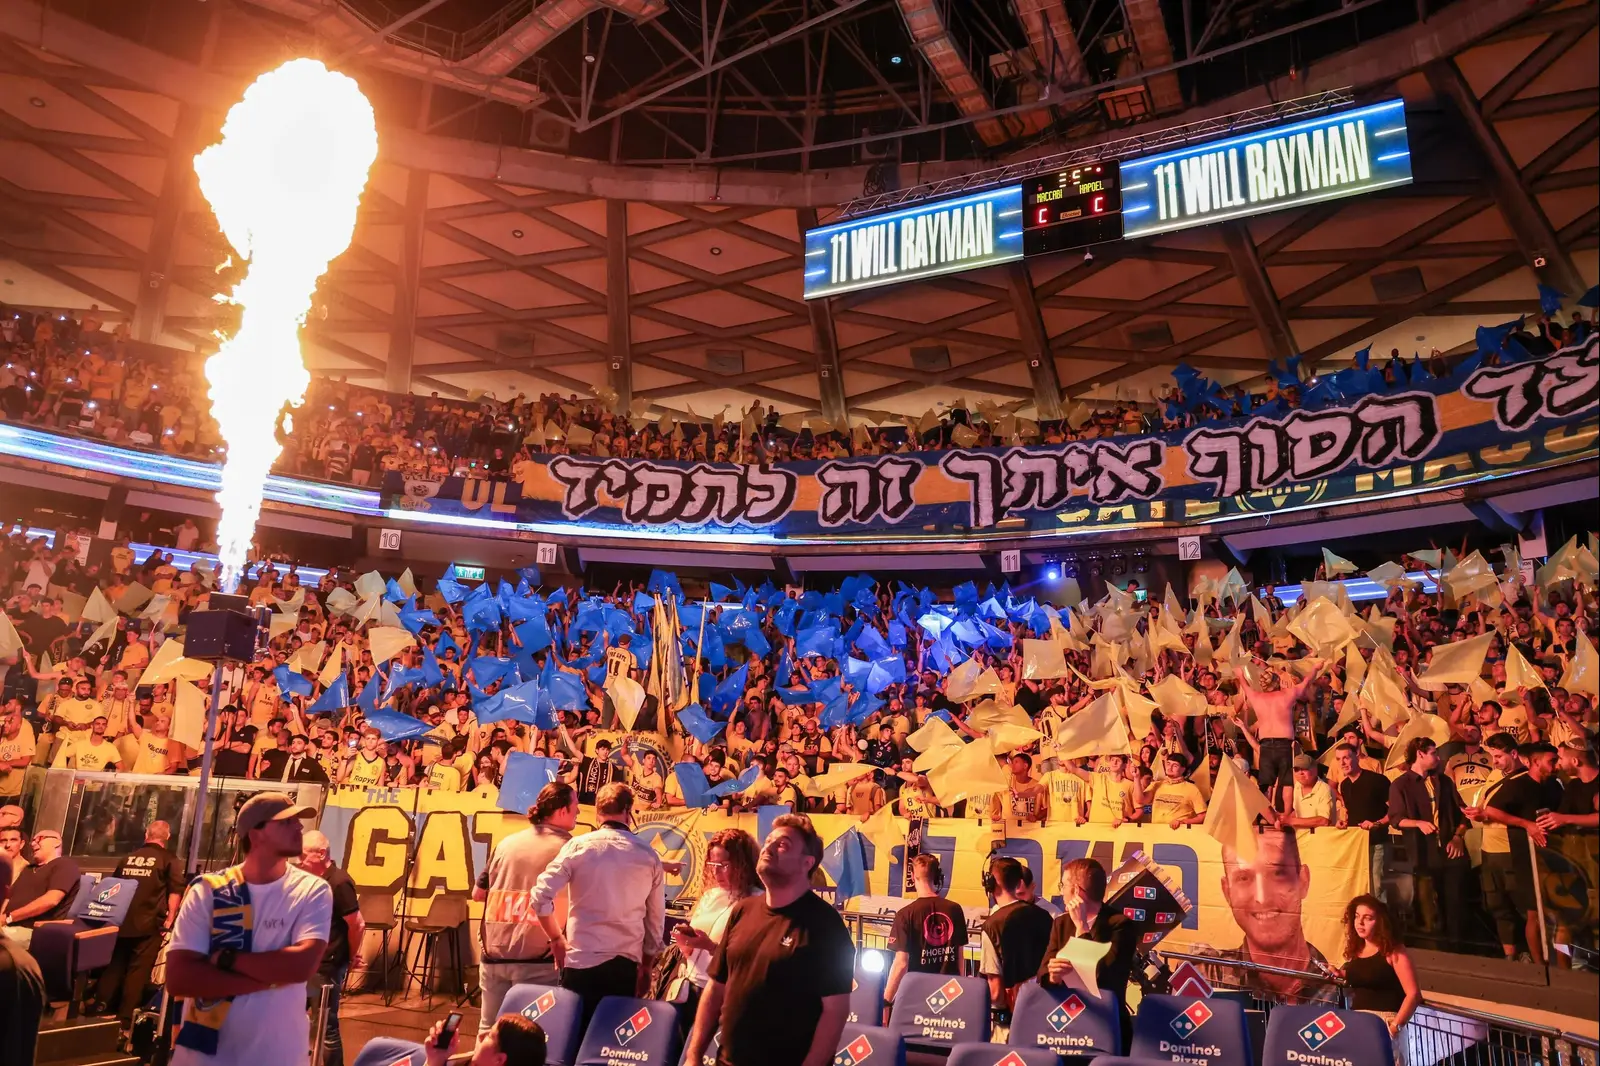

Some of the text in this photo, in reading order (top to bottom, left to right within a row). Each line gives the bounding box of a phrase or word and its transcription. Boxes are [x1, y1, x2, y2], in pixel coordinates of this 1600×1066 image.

[1154, 120, 1371, 220] 11 WILL RAYMAN
[1079, 181, 1104, 194] HAPOEL
[1037, 189, 1063, 203] MACCABI
[830, 201, 993, 283] 11 WILL RAYMAN
[1185, 391, 1441, 497] הסוף
[549, 456, 797, 525] לתמיד
[942, 438, 1165, 527] איתך
[818, 457, 923, 526] זה
[381, 532, 400, 548] 10
[540, 547, 554, 563] 11
[1180, 541, 1200, 559] 12
[1004, 554, 1018, 570] 11
[1465, 765, 1475, 773] 12
[353, 775, 376, 784] Rapyd
[366, 788, 401, 803] THE
[907, 797, 913, 806] 8
[637, 813, 664, 823] YELLOW
[921, 947, 955, 958] PHOENIX
[921, 955, 956, 965] DIVERS
[914, 1014, 966, 1029] Domino's
[922, 1027, 953, 1040] Pizza
[1037, 1034, 1094, 1047] Domino's
[600, 1046, 649, 1062] Domino's
[1160, 1041, 1222, 1057] Domino's
[1286, 1050, 1353, 1066] Domino's
